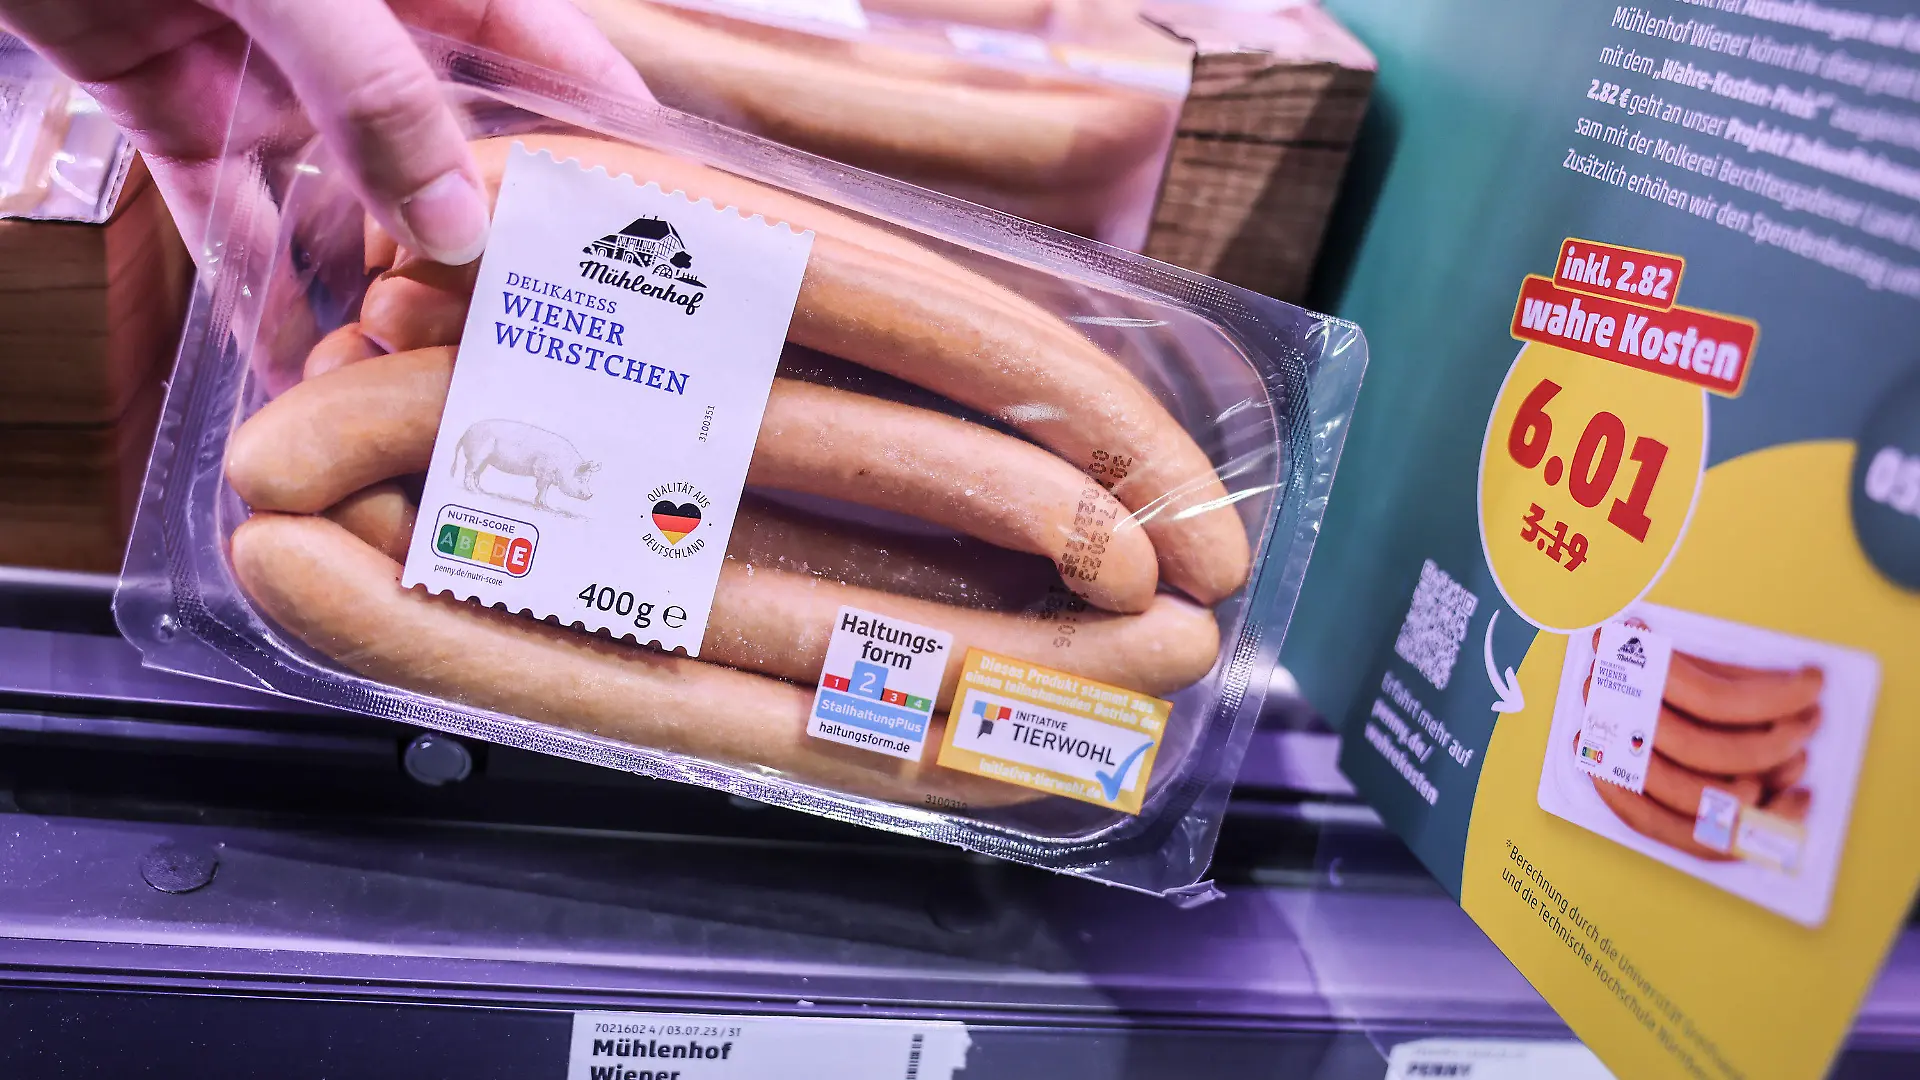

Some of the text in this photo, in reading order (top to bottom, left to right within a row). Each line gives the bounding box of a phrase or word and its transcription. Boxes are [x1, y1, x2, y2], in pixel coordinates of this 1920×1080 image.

[1611, 5, 1694, 43] Mühlenhof
[1690, 20, 1750, 57] Wiener
[1747, 33, 1799, 71] könnt
[1599, 44, 1624, 68] mit
[1623, 49, 1654, 76] dem
[1586, 78, 1792, 156] 2.82 € geht an unser Projekt
[1575, 117, 1603, 140] sam
[1602, 124, 1629, 148] mit
[1627, 131, 1654, 156] der
[1652, 138, 1720, 178] Molkerei
[1562, 147, 1631, 188] Zusätzlich
[1627, 174, 1688, 210] erhöhen
[1688, 193, 1718, 220] wir
[1715, 200, 1750, 232] den
[505, 272, 618, 314] DELIKATESS
[579, 258, 706, 317] Mühlenhof
[1561, 246, 1674, 300] inkl. 2.82
[502, 291, 625, 347] WIENER
[1520, 296, 1741, 383] wahre Kosten
[494, 320, 691, 397] WÜRSTCHEN
[698, 405, 716, 443] 3100351
[1507, 377, 1669, 544] 6.01
[647, 481, 711, 509] QUALITÄT AUS
[447, 510, 516, 534] NUTRI-SCORE
[1520, 502, 1589, 573] 3.19
[511, 545, 528, 567] E
[641, 532, 705, 559] DEUTSCHLAND
[434, 563, 503, 587] penny.de/nutri-score
[840, 613, 944, 655] Haltungs-
[861, 642, 913, 671] form
[1599, 667, 1628, 683] WIENER
[833, 672, 923, 709] 1 2 3 4
[965, 671, 1162, 731] einem teilnehmenden Betrieb der
[980, 655, 1155, 714] Dieses Produkt stammt aus
[1597, 676, 1642, 698] WÜRSTCHEN
[820, 697, 923, 734] StallhaltungPlus
[1015, 710, 1069, 731] INITIATIVE
[818, 721, 911, 753] haltungsform.de
[1012, 723, 1117, 766] TIERWOHL
[1418, 709, 1452, 748] mehr
[1448, 738, 1474, 768] auf
[1501, 867, 1656, 1032] und die Technische Hochschule
[1569, 906, 1599, 942] durch
[1599, 938, 1618, 960] die
[592, 1038, 733, 1060] Mühlenhof
[595, 1023, 647, 1034] 7021602
[667, 1025, 718, 1036] 03.07.23
[590, 1064, 681, 1080] Wiener
